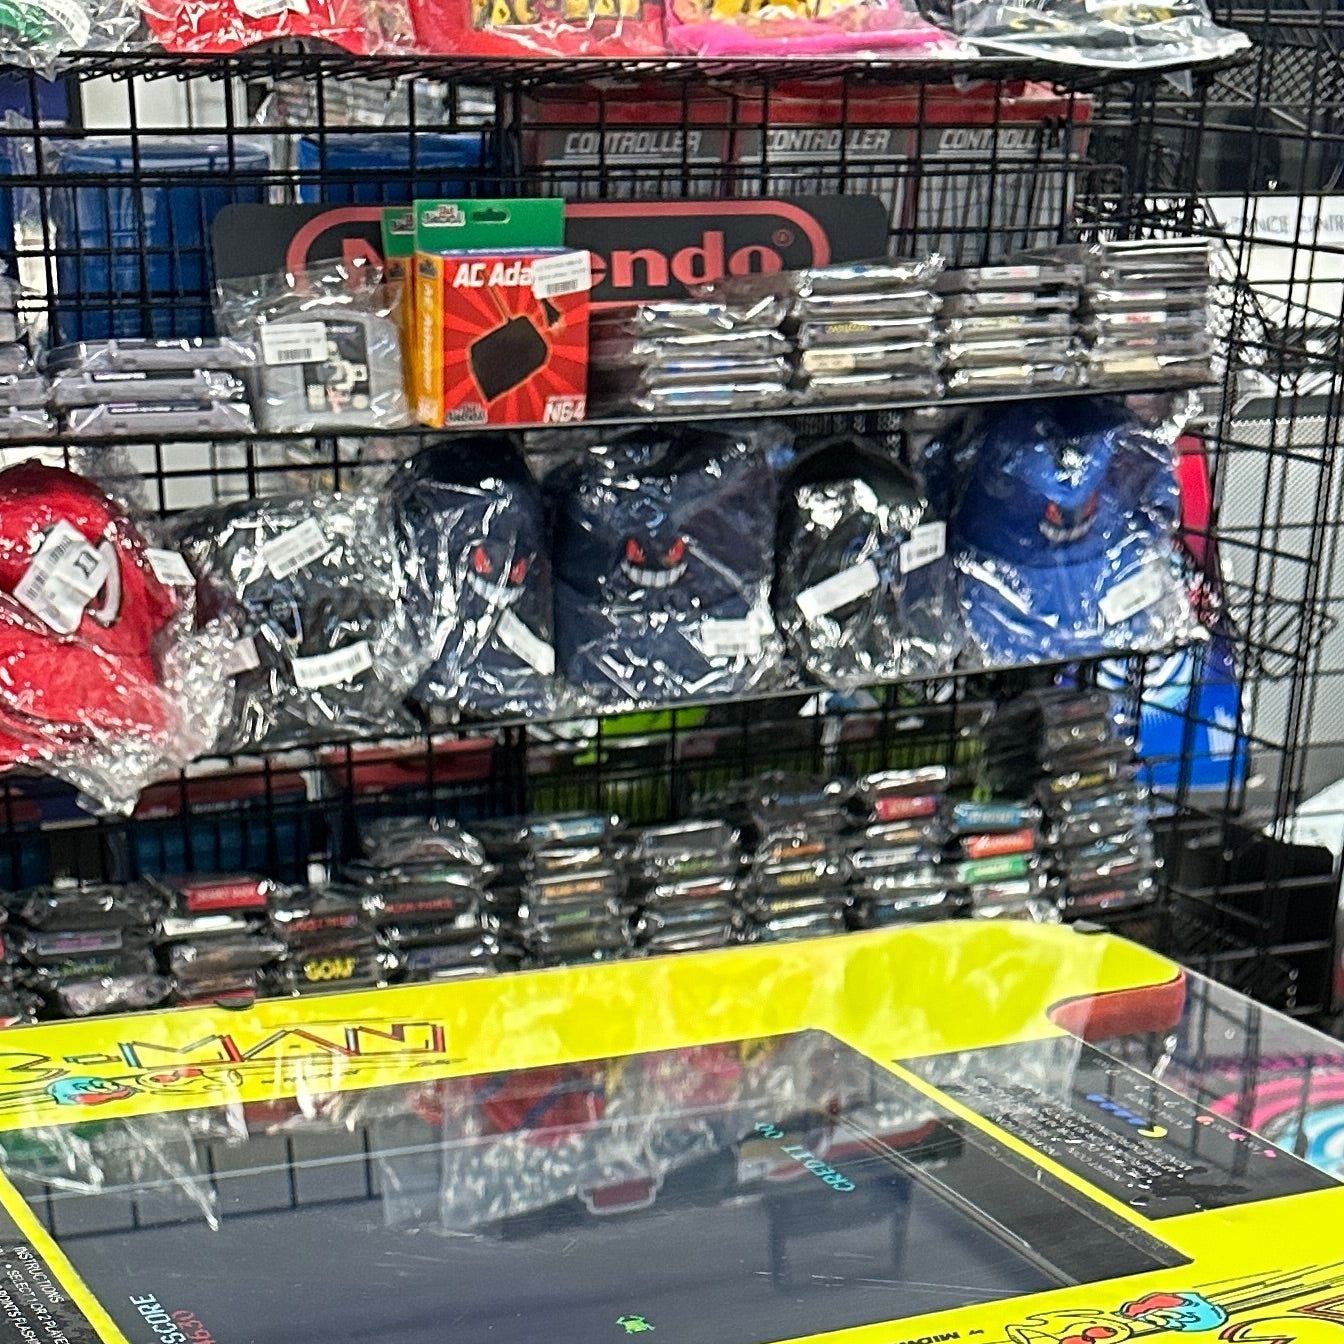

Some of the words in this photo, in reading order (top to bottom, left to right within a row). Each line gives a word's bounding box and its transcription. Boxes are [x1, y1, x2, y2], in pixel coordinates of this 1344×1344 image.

[453, 262, 486, 288] AC
[780, 1145, 855, 1191] CREDIT
[4, 1269, 36, 1297] SELECT
[28, 1302, 47, 1314] OR
[11, 1246, 65, 1303] INSTRUCTIONS
